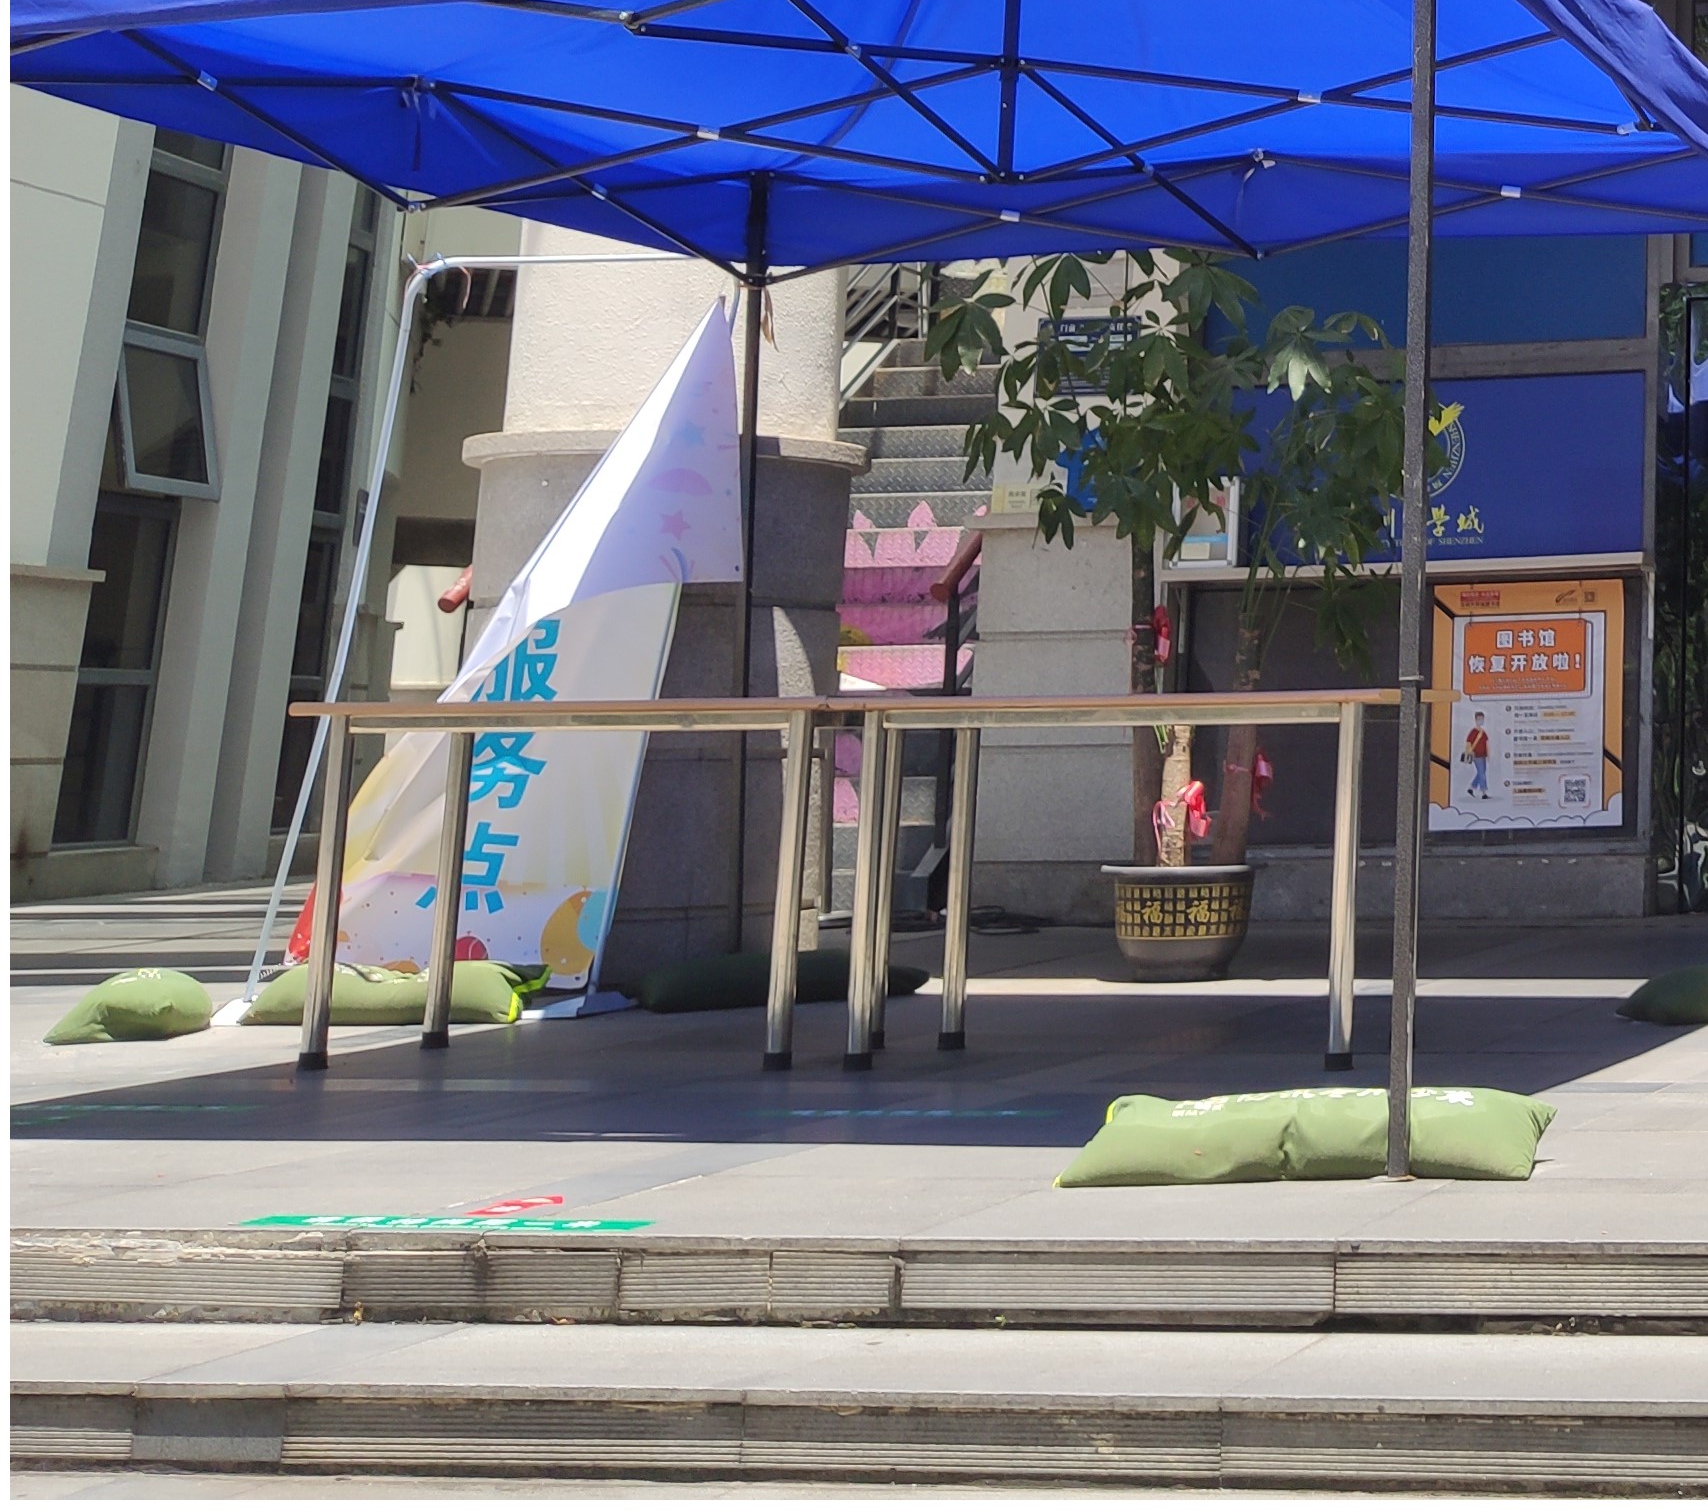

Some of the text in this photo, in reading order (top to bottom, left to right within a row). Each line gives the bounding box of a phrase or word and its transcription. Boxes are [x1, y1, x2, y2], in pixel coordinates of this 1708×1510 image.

[1496, 629, 1556, 648] 图书馆
[1468, 652, 1582, 674] 恢复开放啦！
